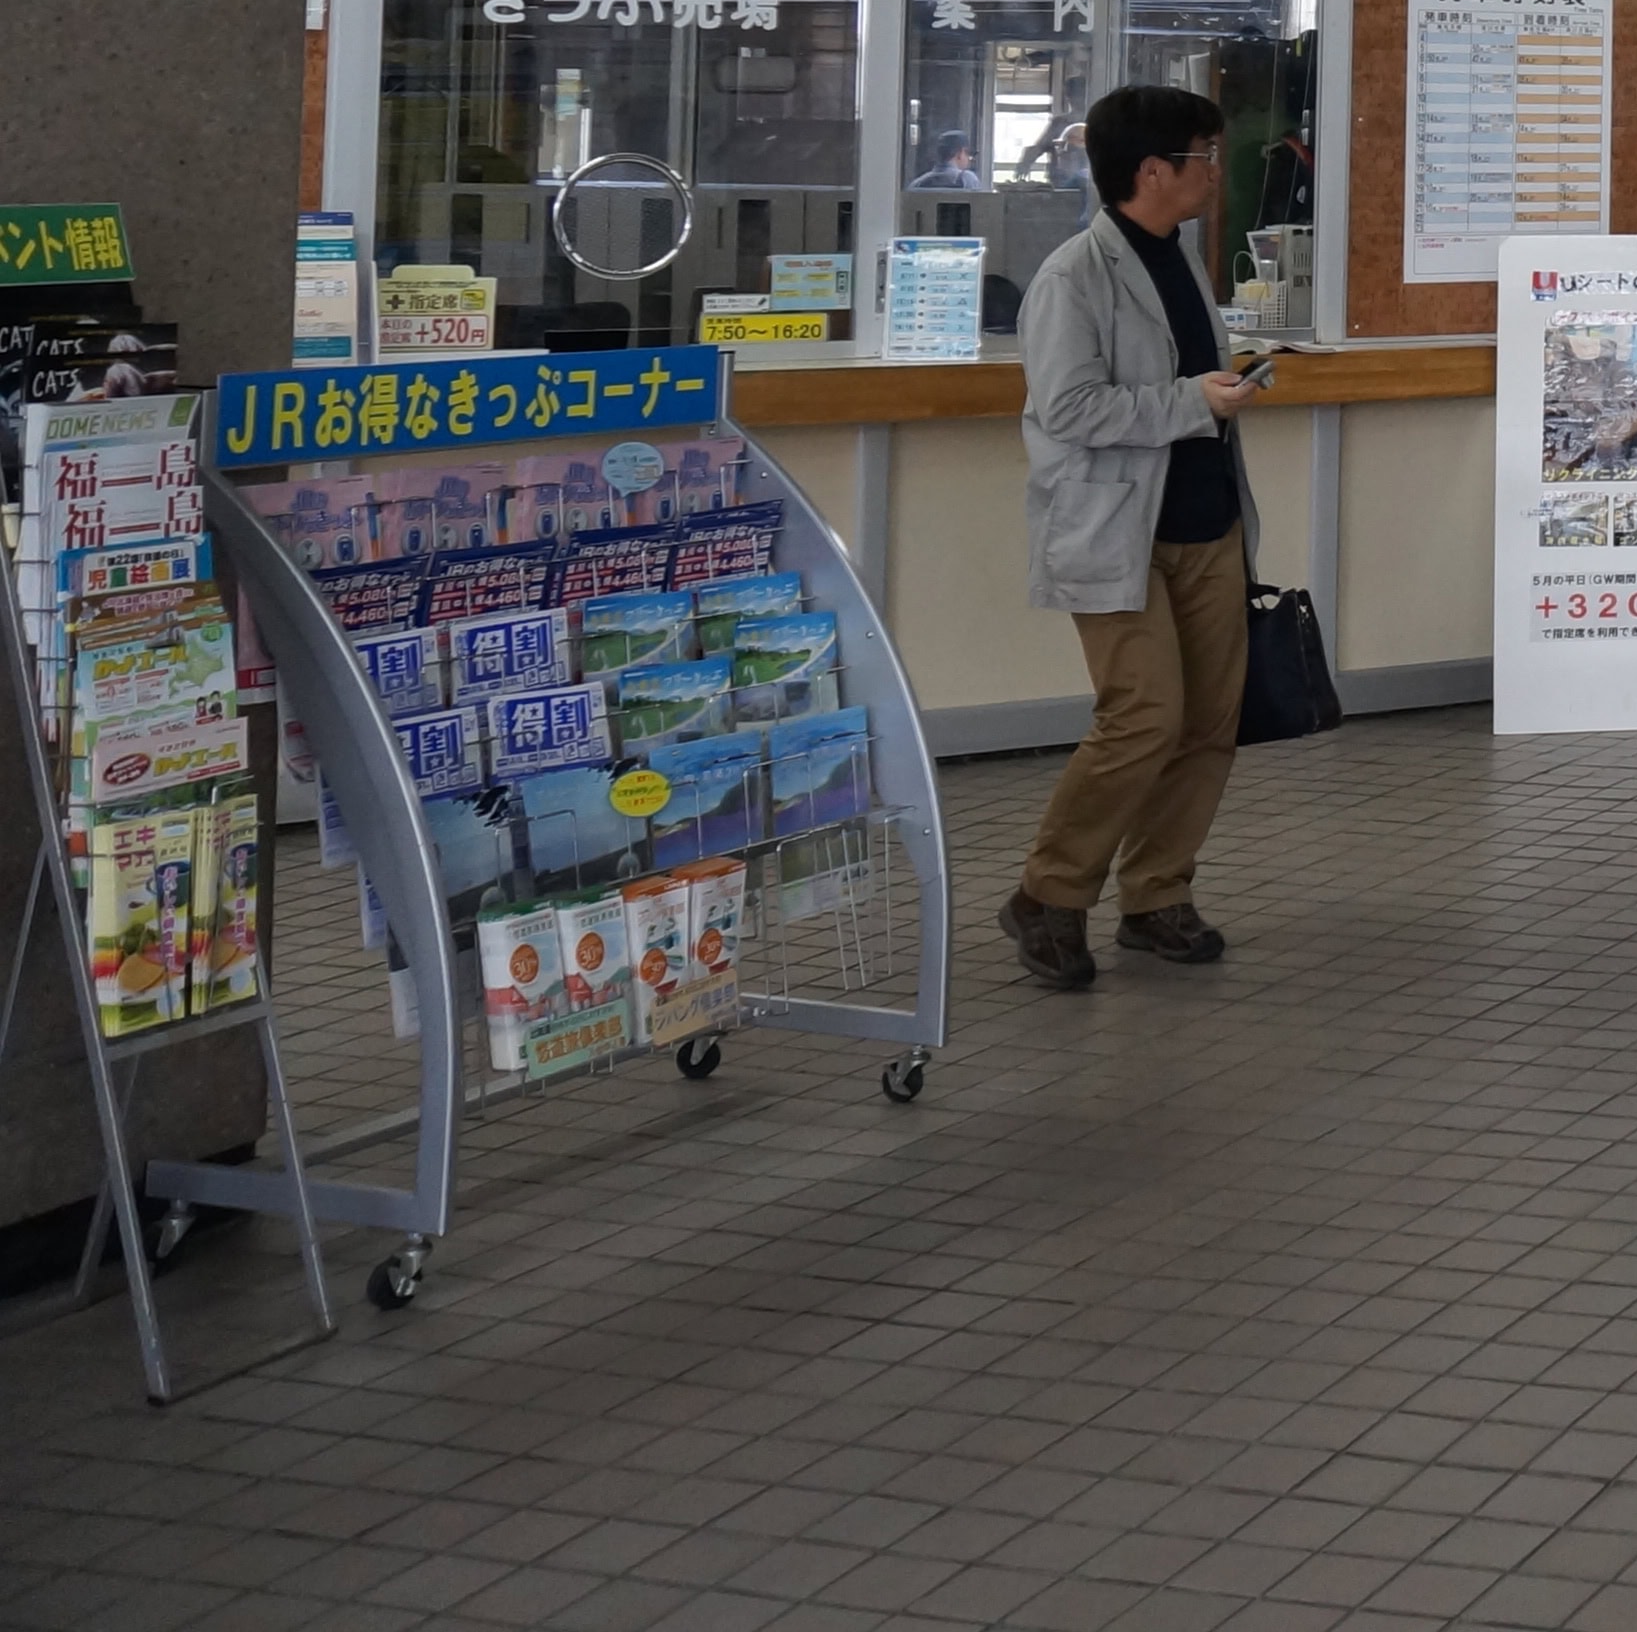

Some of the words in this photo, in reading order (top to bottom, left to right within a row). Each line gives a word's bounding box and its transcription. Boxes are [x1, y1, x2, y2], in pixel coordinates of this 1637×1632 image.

[1425, 12, 1472, 24] 発車時刻
[1524, 14, 1570, 26] 到着時刻
[0, 217, 124, 271] ント情報
[705, 323, 823, 342] 7:50～16:20
[32, 368, 79, 398] CATS
[226, 356, 705, 455] JRお得なきっぷコーナー
[472, 623, 558, 679] 得割
[511, 693, 592, 749] 得割
